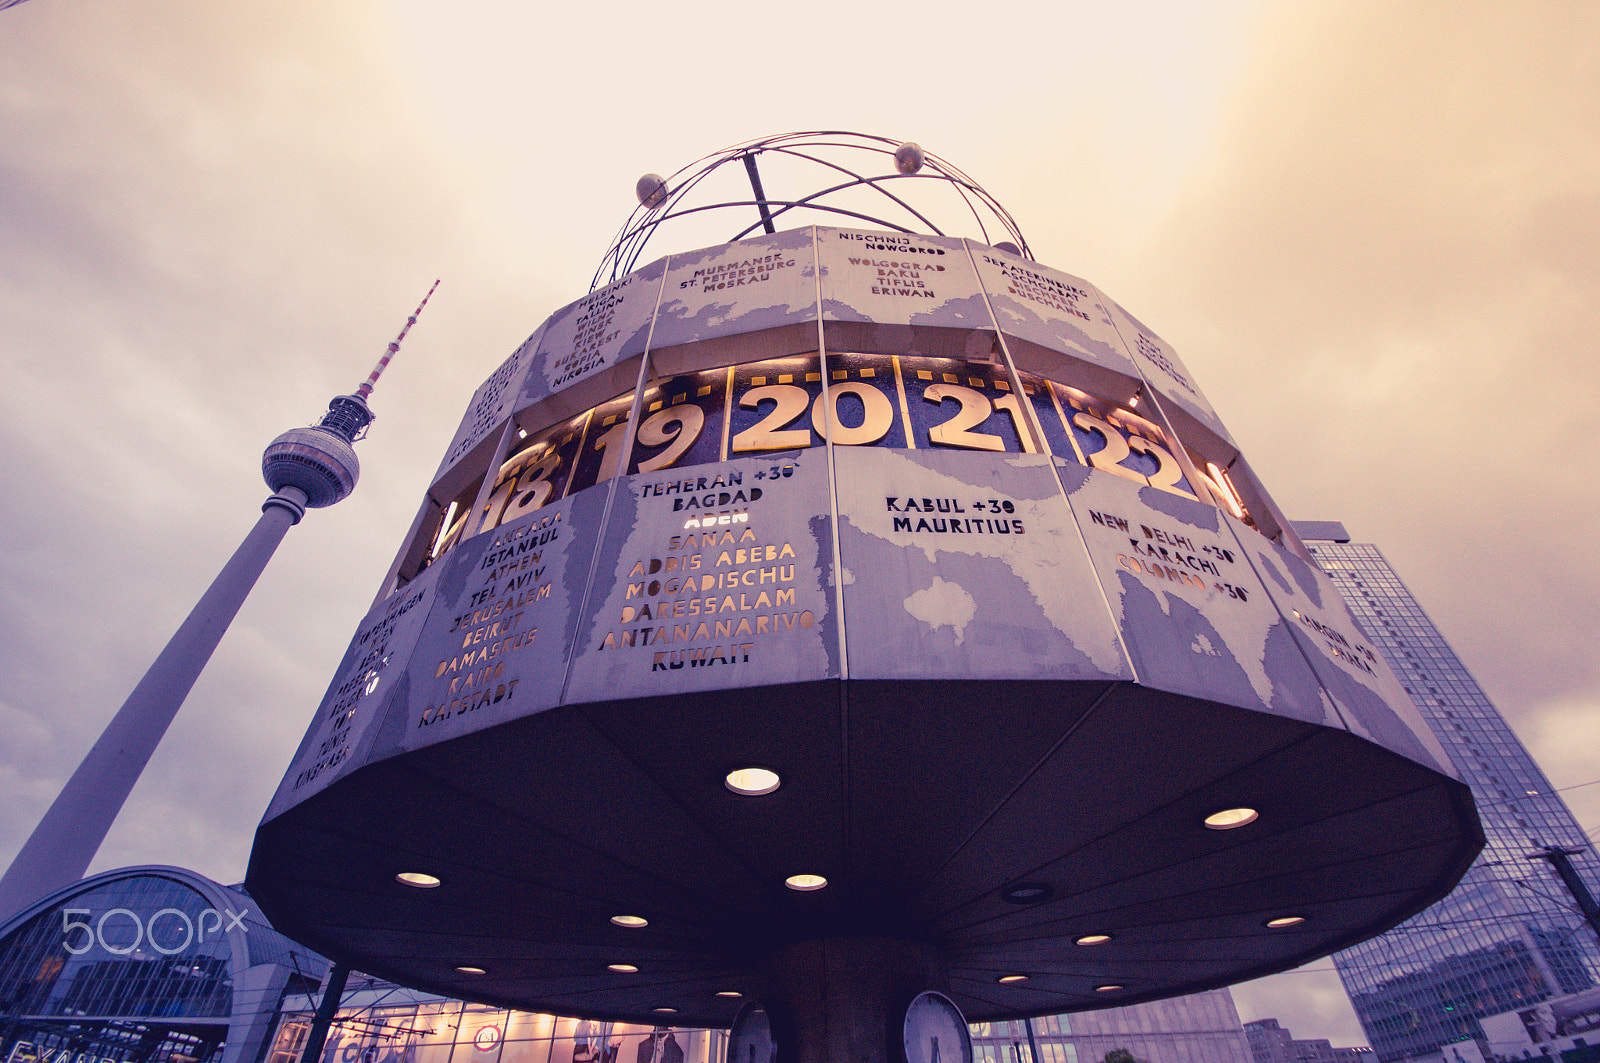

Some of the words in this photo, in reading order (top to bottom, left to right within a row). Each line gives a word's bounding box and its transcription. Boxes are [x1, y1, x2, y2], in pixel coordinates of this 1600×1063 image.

[839, 233, 910, 245] NISCHNIJ
[866, 243, 945, 255] NOWGOROD
[680, 279, 698, 289] ST.
[702, 259, 796, 284] PETERSBURG
[694, 253, 783, 278] MURMANSK
[848, 257, 945, 271] WOLGOGRAD
[877, 269, 920, 279] BAKU
[983, 255, 1088, 297] JEKATERINBURG
[578, 278, 632, 309] HELSINKI
[703, 273, 770, 293] MOSKAU
[871, 286, 935, 298] ERIWAN
[877, 278, 925, 288] TIFLIS
[1001, 269, 1079, 301] ASCHGABAT
[1012, 280, 1077, 309] BISCHKEK
[576, 296, 624, 325] TALLINN
[587, 294, 616, 312] RIGA
[1007, 286, 1091, 321] DUSCHANBE
[573, 319, 612, 342] MINSK
[577, 309, 615, 332] WILNA
[554, 330, 621, 369] BUKAREST
[574, 329, 606, 350] KIEW
[552, 357, 605, 388] NIKOSIA
[564, 349, 600, 371] SOFIA
[732, 381, 893, 452] 20
[923, 383, 1052, 456] 21
[594, 403, 704, 484] 19
[1073, 412, 1200, 502] 22
[478, 453, 560, 534] 18
[641, 471, 743, 498] TEHERAN
[672, 488, 763, 512] BAGDAD
[683, 508, 749, 529] ADEN
[886, 497, 965, 513] KABUL
[973, 499, 1015, 514] +30
[489, 511, 562, 550] ANKARA
[668, 527, 757, 550] SANAA
[893, 517, 1025, 534] MAURITIUS
[1089, 509, 1130, 533] NEW
[1140, 524, 1196, 552] DELHI
[481, 528, 559, 570] ISTANBUL
[628, 554, 702, 578] ADDIS
[715, 543, 796, 567] ABEBA
[1129, 538, 1221, 576] KARACHI
[485, 550, 543, 585] ATHEN
[625, 563, 795, 600] MOGADISCHU
[1116, 553, 1206, 590] COLOMBO
[470, 585, 496, 608] TEL
[502, 566, 546, 593] AVIV
[449, 582, 552, 634] JERUSALEM
[620, 587, 796, 624] DARESSALAM
[462, 611, 525, 649] BEIRUT
[597, 610, 814, 651] ANTANANARIVO
[434, 628, 538, 679] DAMASKUS
[652, 642, 754, 672] KUWAIT
[446, 661, 505, 697] KAIRO
[418, 679, 519, 729] KAPSTADT
